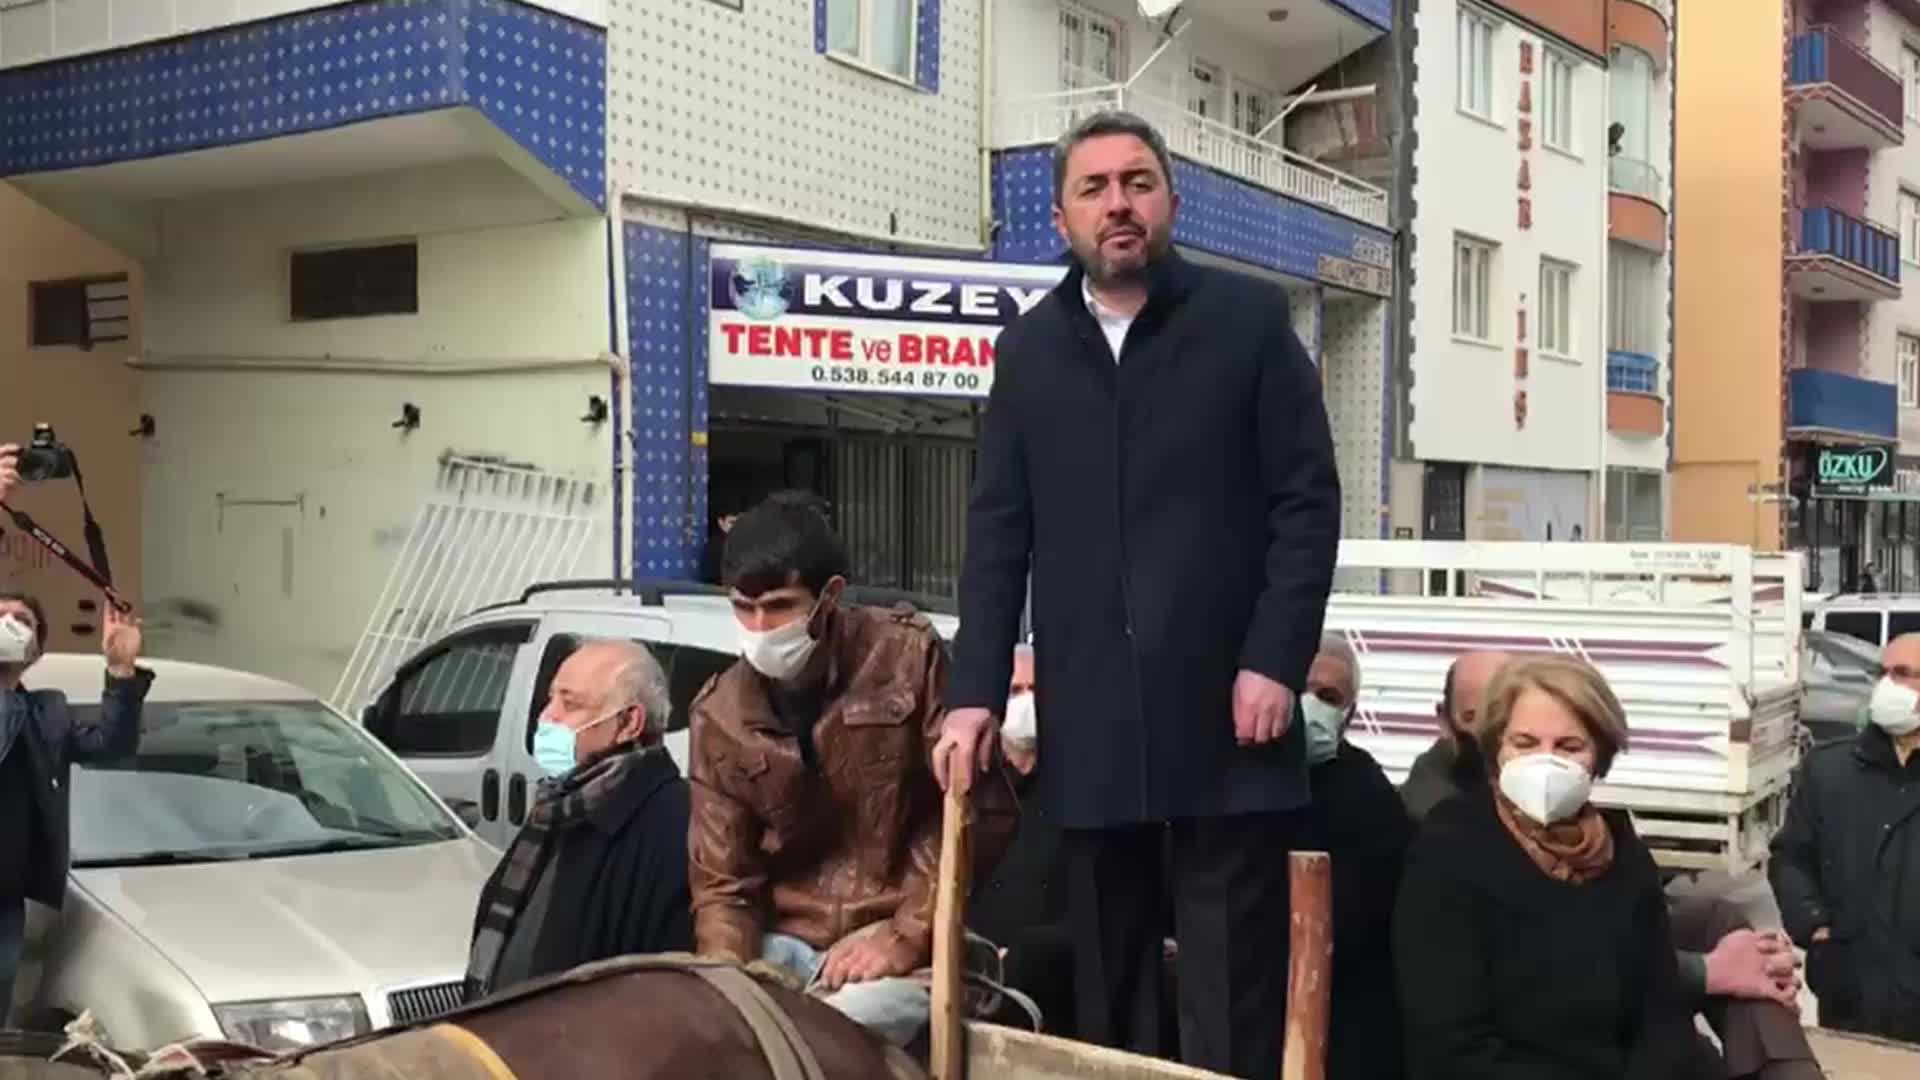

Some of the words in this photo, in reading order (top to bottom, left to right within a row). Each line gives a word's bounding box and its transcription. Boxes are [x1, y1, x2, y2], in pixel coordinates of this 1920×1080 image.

[804, 274, 1051, 316] KUZEY
[720, 323, 854, 361] TENTE
[861, 338, 892, 363] ve
[811, 365, 915, 386] 0.538.544
[921, 371, 947, 388] 87
[953, 372, 979, 389] 00
